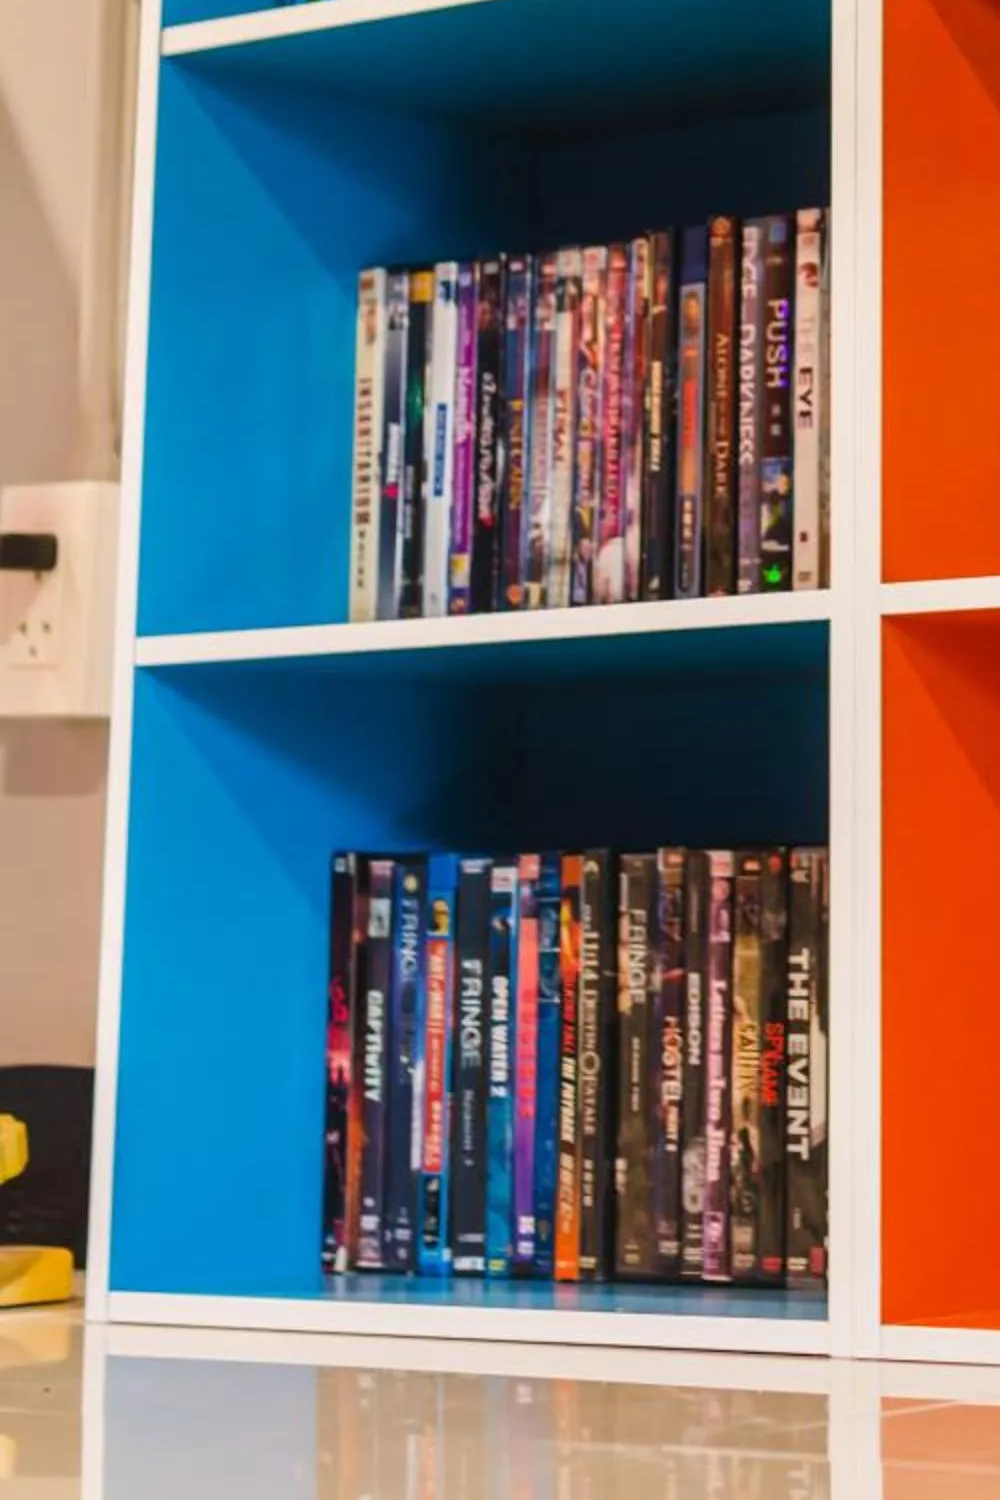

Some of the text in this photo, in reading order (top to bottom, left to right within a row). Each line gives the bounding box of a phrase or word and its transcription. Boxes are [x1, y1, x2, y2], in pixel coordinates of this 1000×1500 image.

[765, 299, 788, 388] PUSH
[798, 367, 813, 430] EYE
[628, 908, 648, 1004] FRINGE
[461, 959, 483, 1069] FRINGE
[491, 976, 509, 1098] OPEN WATER 2
[661, 1015, 684, 1105] HOSTEL
[687, 972, 702, 1066] EDISON
[786, 948, 811, 1161] THE EVENT
[705, 1124, 726, 1183] Jima
